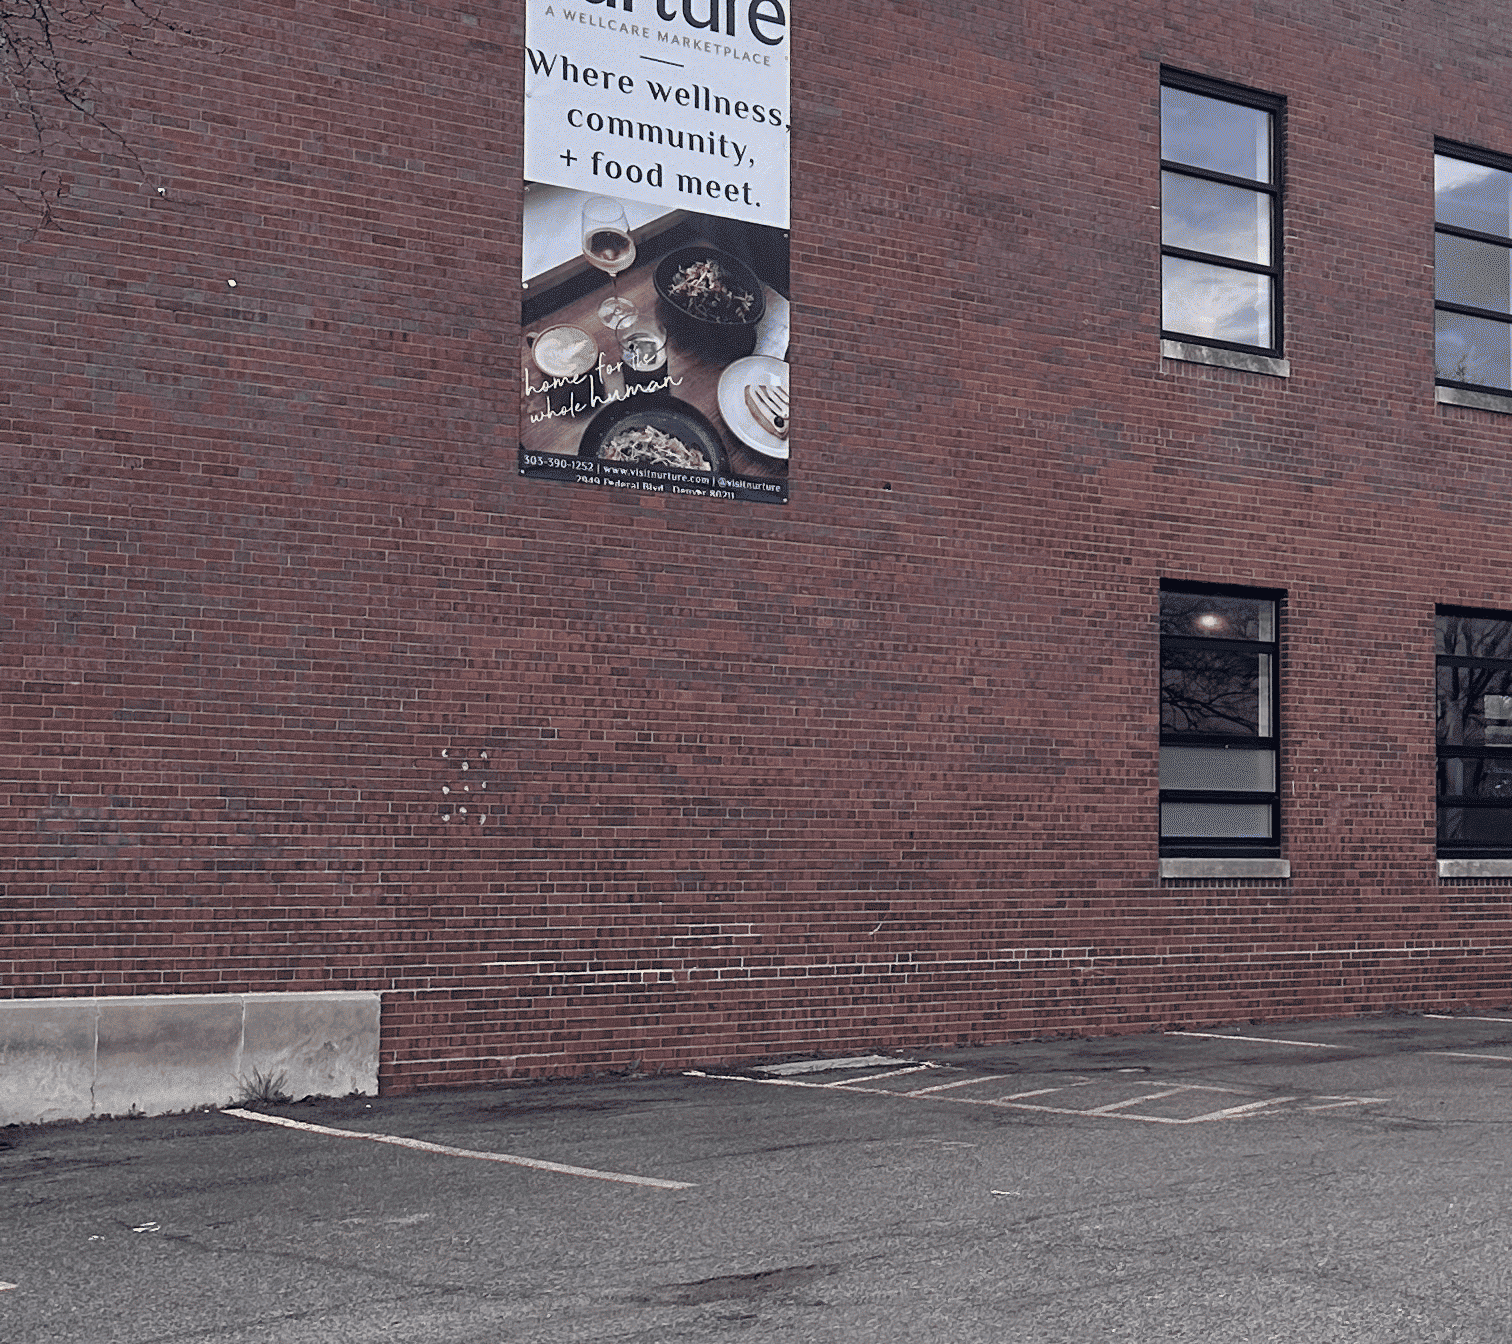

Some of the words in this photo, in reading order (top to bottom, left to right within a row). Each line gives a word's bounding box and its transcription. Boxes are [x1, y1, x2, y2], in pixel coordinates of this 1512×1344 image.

[545, 5, 555, 17] A
[563, 8, 650, 39] WELLCARE
[657, 30, 771, 67] MARKETPLACE
[525, 46, 634, 94] Where
[646, 80, 791, 132] wellness,
[567, 108, 754, 167] community,
[591, 151, 663, 188] food
[676, 173, 761, 207] meet.
[524, 367, 588, 397] home
[595, 351, 624, 385] for
[629, 347, 656, 371] the
[530, 391, 587, 423] whole
[589, 374, 684, 408] human
[523, 454, 595, 472] 303-390-1252
[603, 465, 710, 485] www.visitnurture.com
[603, 477, 640, 490] Federal
